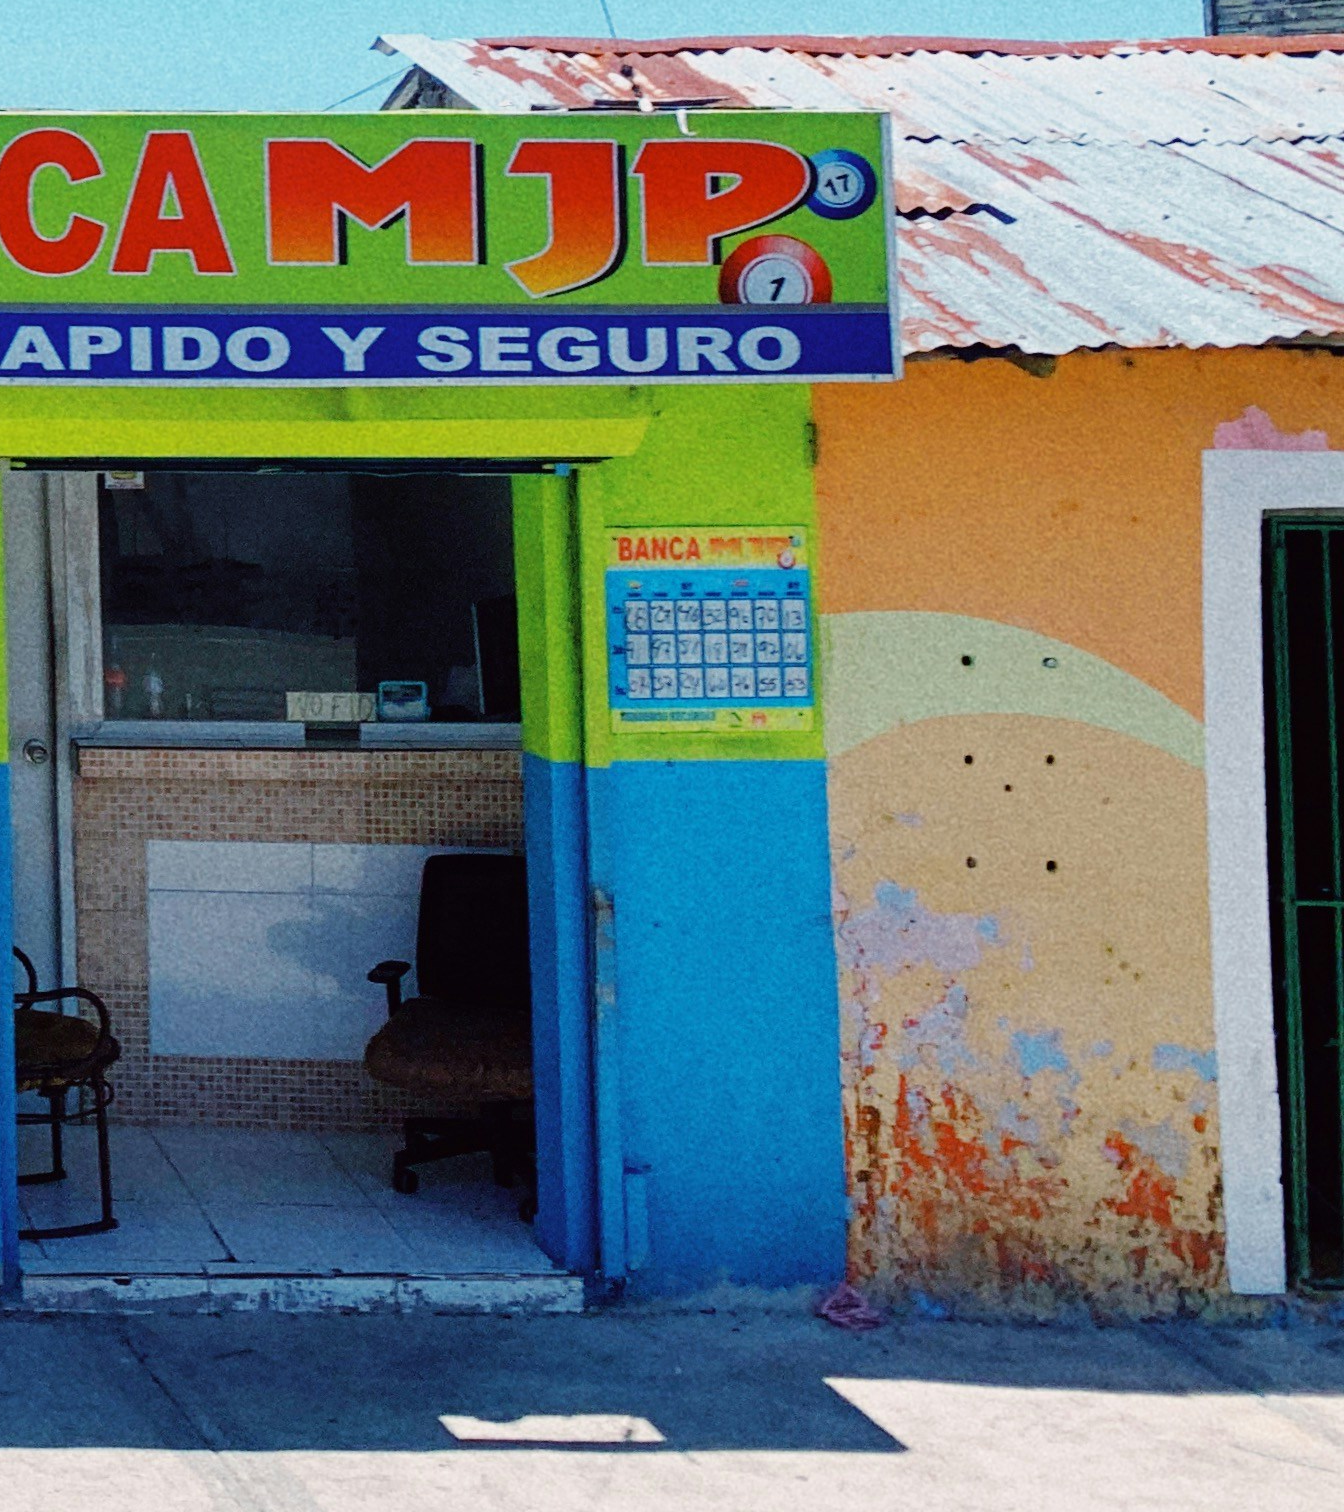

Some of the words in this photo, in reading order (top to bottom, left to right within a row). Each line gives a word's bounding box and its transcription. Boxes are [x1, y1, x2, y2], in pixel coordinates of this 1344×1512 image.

[824, 173, 850, 197] 17
[321, 326, 386, 373] Y
[416, 325, 802, 373] SEGURO
[617, 536, 702, 562] BANCA
